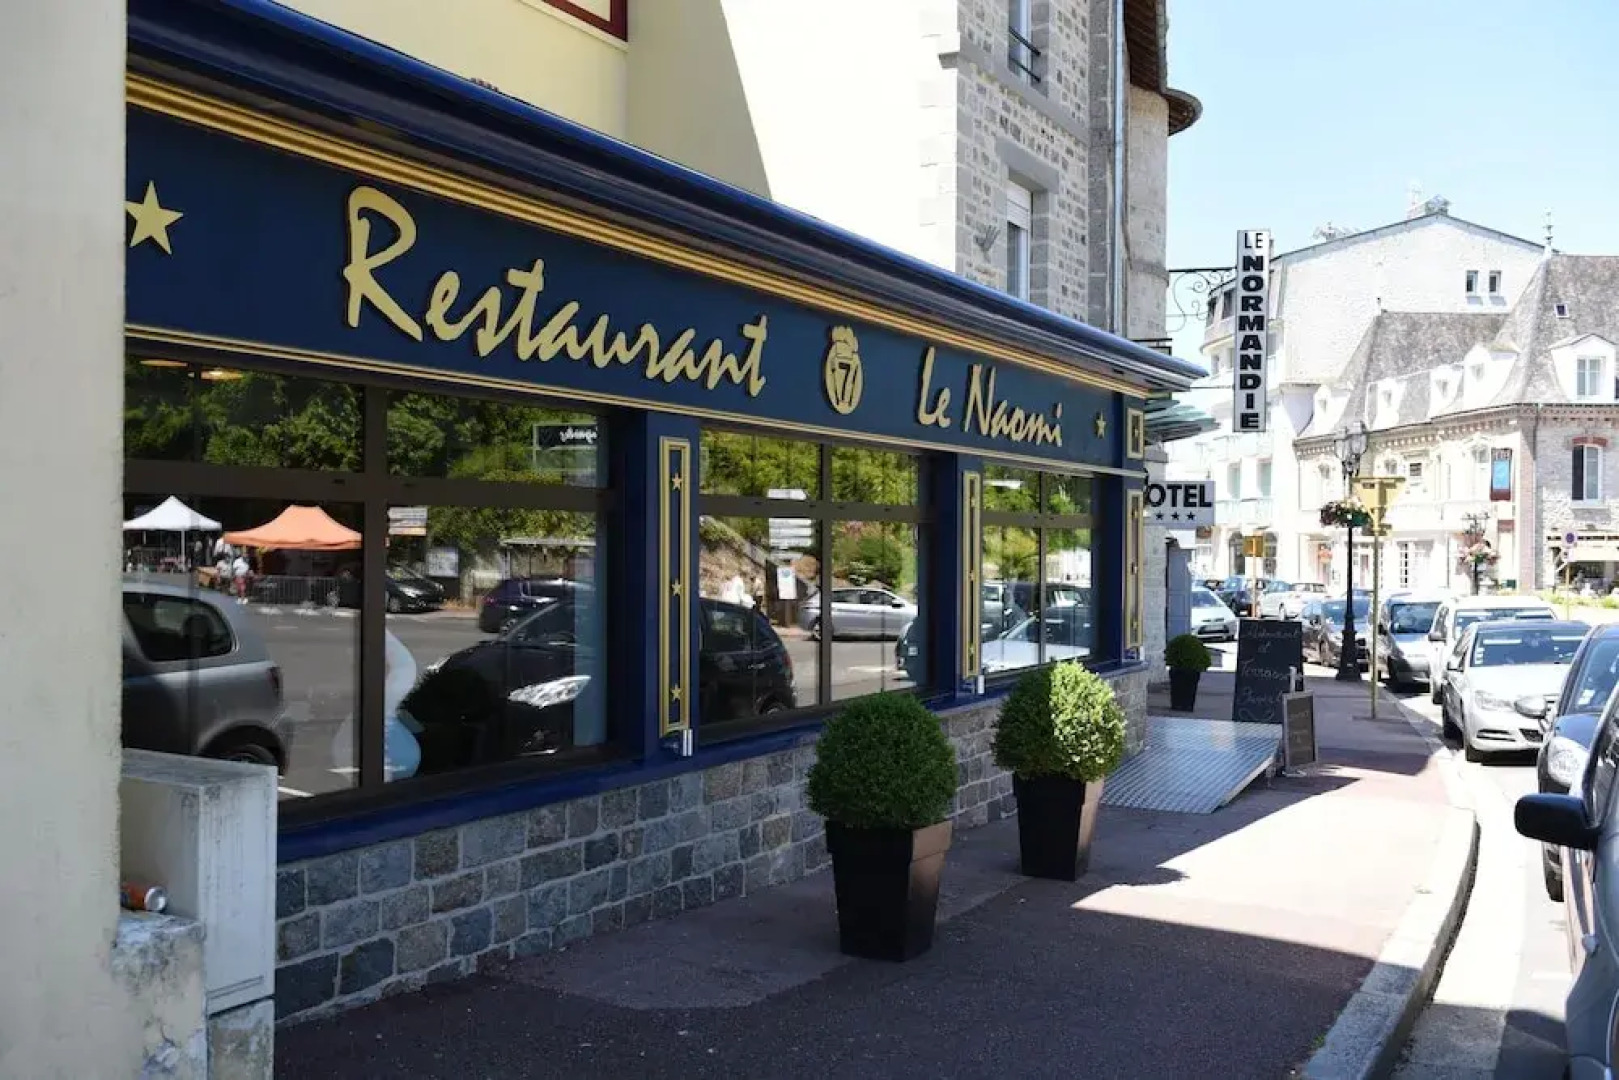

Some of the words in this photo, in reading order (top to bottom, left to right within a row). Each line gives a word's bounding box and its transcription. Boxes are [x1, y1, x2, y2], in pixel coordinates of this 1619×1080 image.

[1244, 232, 1263, 249] LE
[343, 185, 768, 398] Restaurant
[964, 363, 1063, 447] Naomi
[1238, 255, 1264, 429] NORMANDIE
[1147, 483, 1212, 508] OTEL
